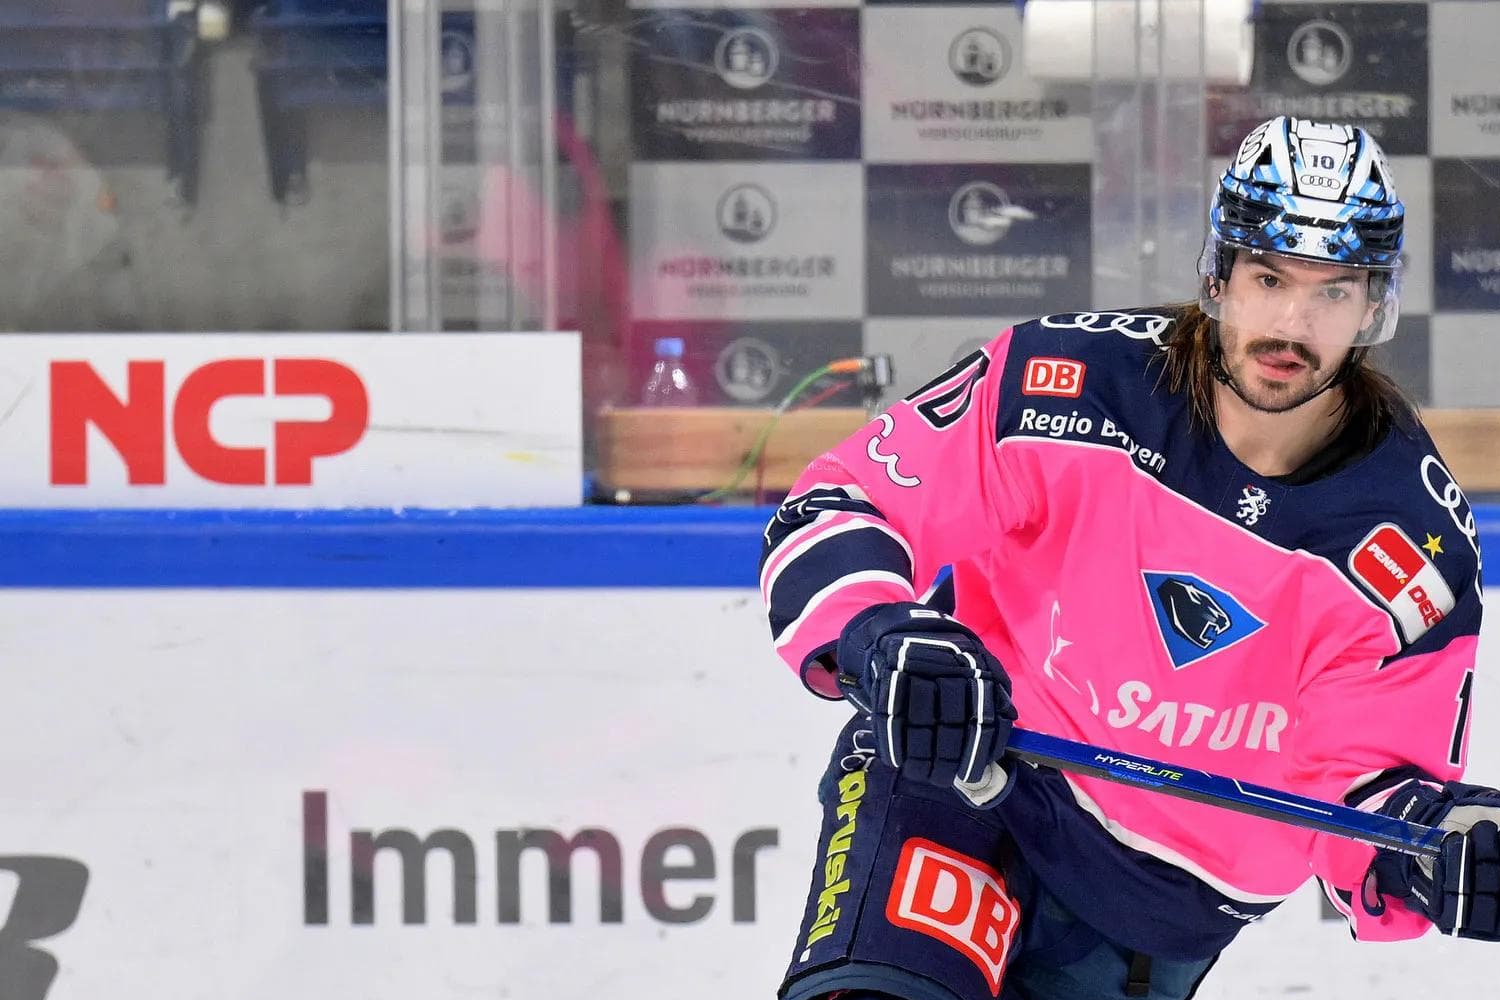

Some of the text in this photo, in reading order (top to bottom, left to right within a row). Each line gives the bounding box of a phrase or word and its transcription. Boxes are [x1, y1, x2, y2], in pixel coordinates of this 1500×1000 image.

[1311, 154, 1335, 170] 10
[1030, 362, 1076, 390] DB
[49, 358, 370, 486] NCP
[1019, 408, 1093, 437] Regio
[1107, 680, 1289, 753] SATUR
[1095, 754, 1183, 780] HYPERLITE
[302, 789, 779, 926] Immer
[909, 855, 1014, 966] DB
